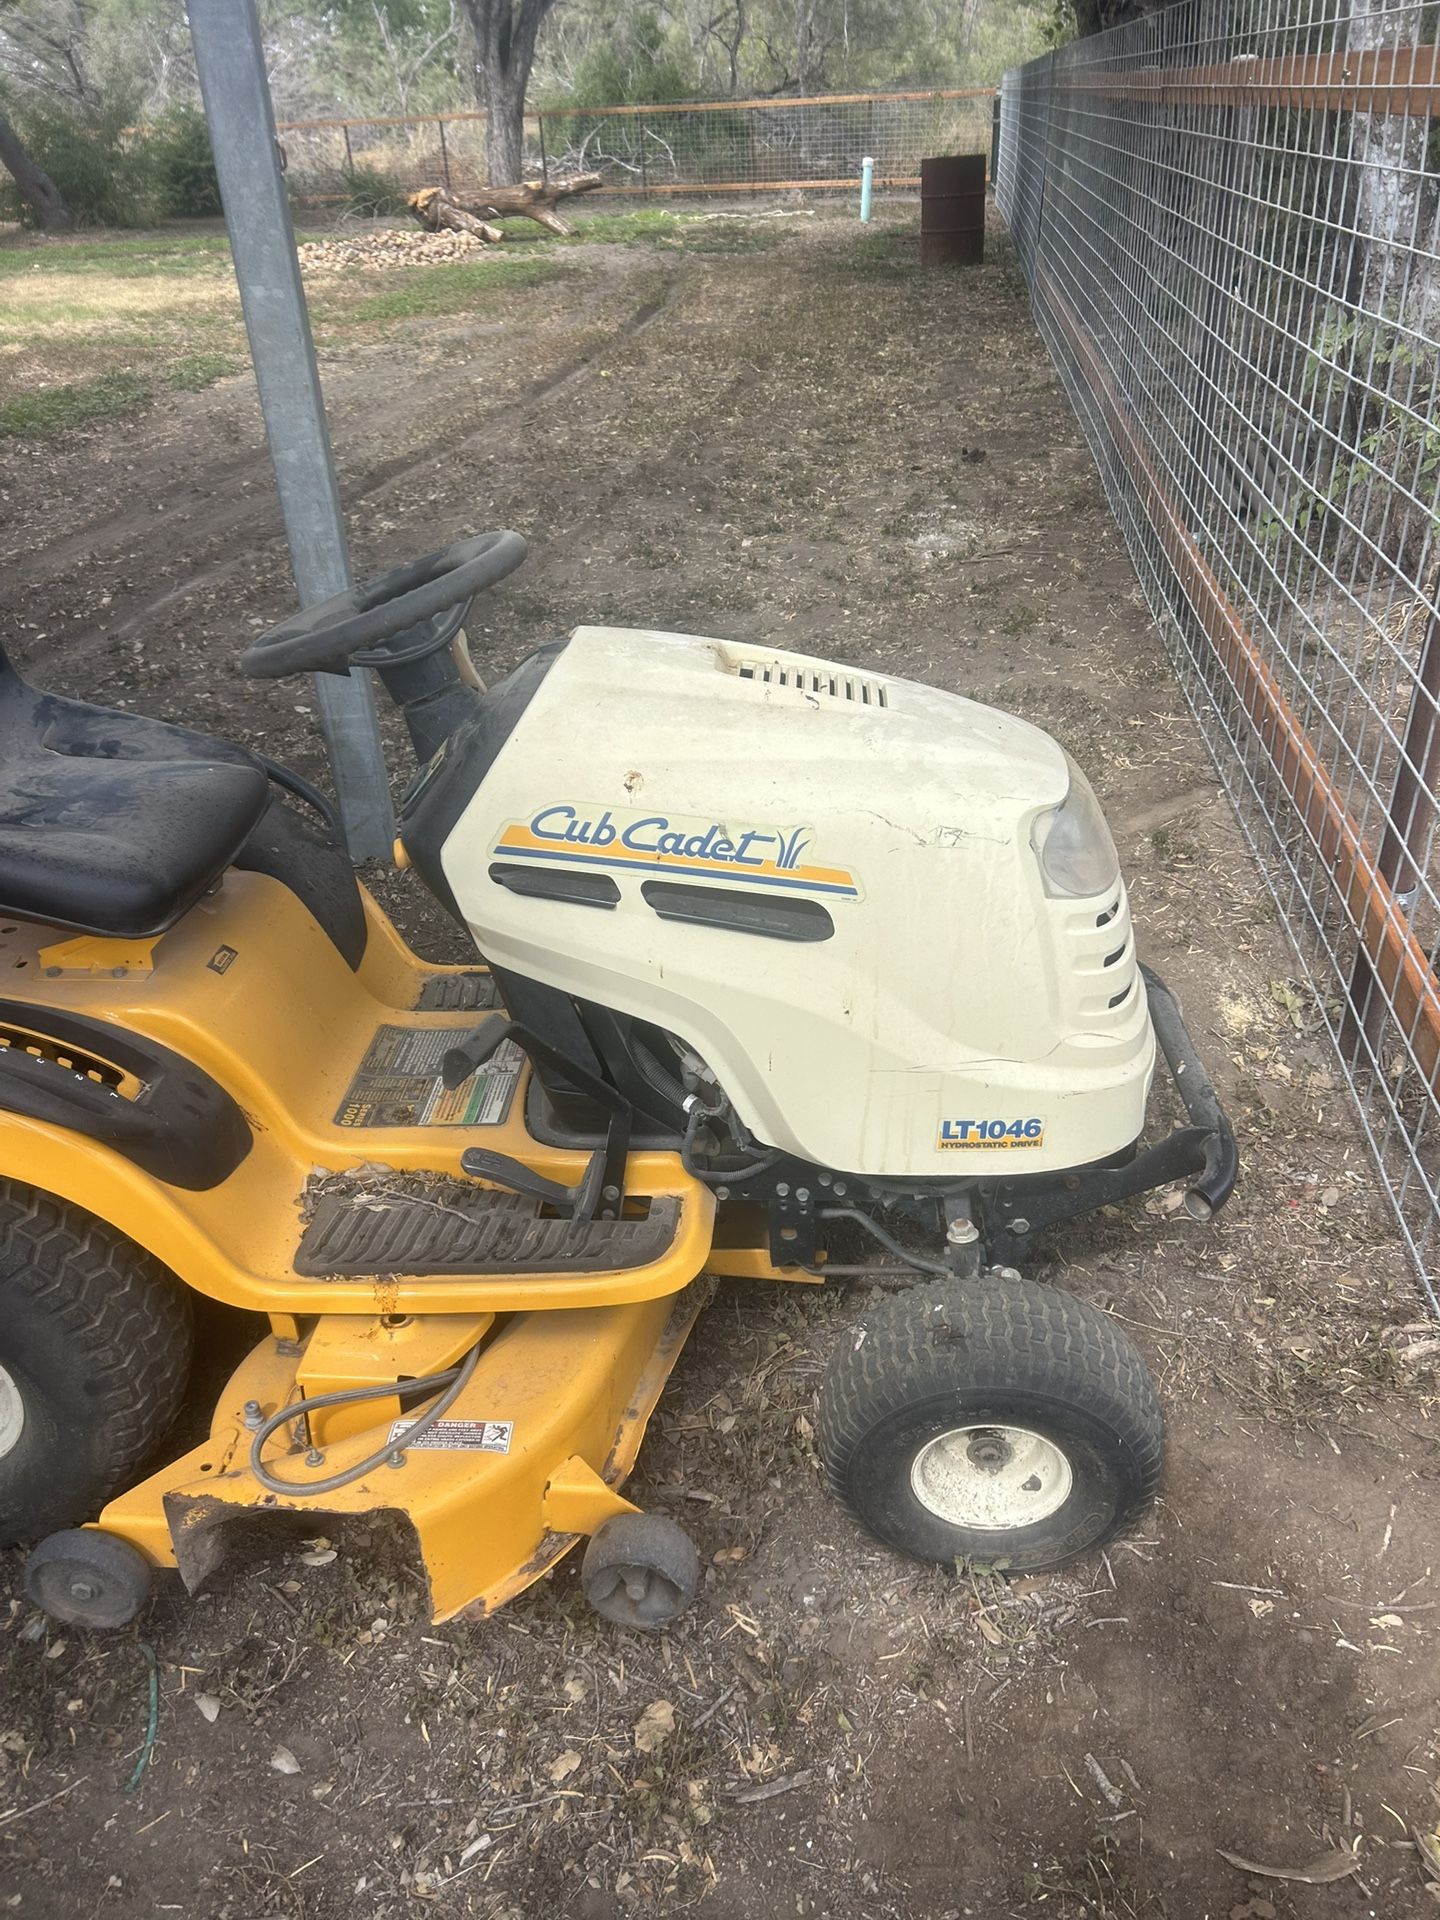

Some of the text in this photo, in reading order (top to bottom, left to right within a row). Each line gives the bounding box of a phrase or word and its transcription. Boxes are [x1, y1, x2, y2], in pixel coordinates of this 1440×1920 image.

[530, 806, 776, 865] Cub Cadet
[341, 1104, 361, 1125] 1000
[942, 1119, 1041, 1139] LT1046
[941, 1140, 1039, 1149] HYDROSTATIC DRIVE
